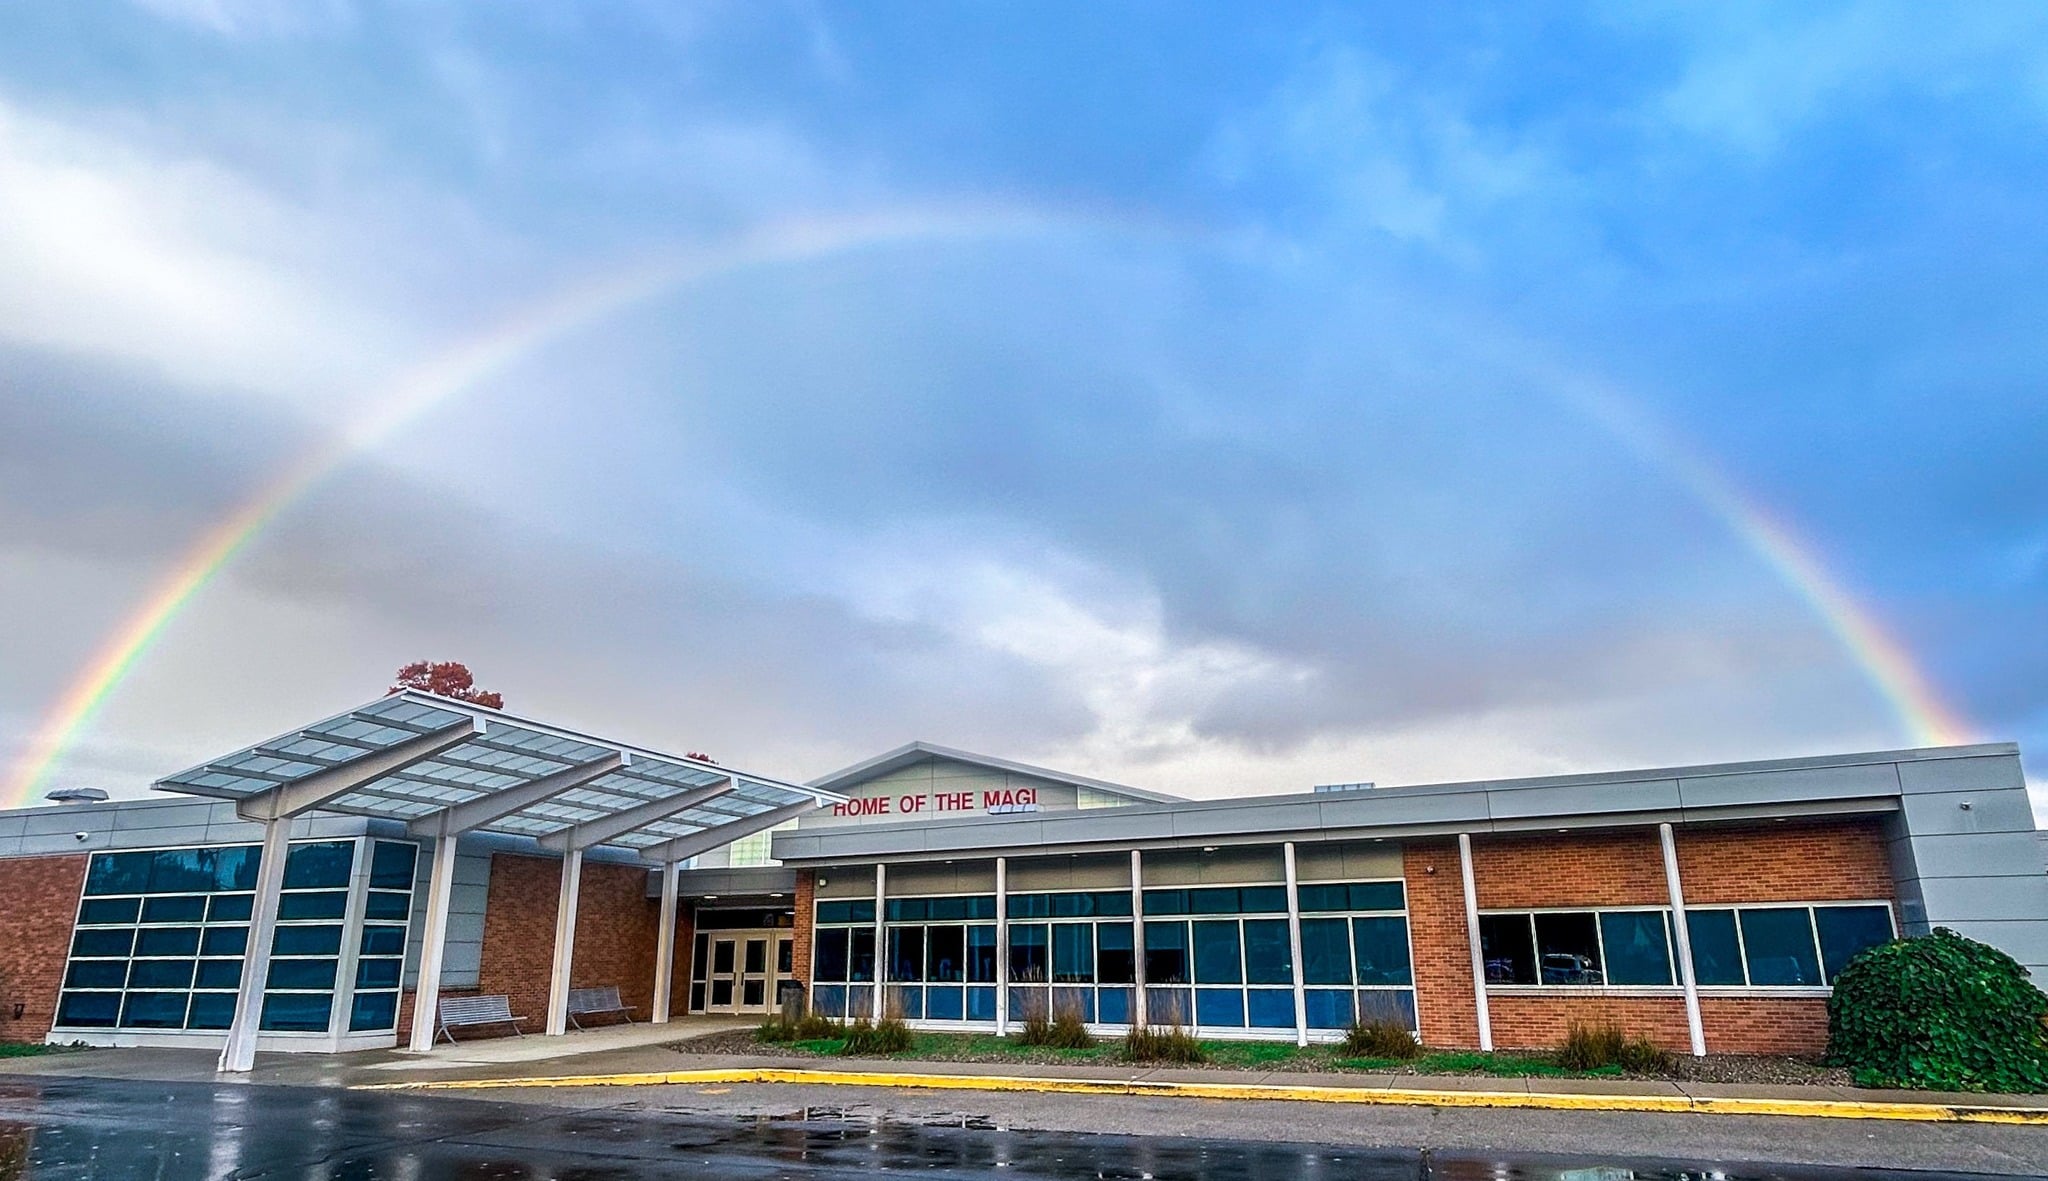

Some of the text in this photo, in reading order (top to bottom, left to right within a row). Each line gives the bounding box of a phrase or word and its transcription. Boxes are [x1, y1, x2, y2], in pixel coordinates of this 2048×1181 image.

[833, 788, 1037, 816] HOME OF THE MAGI
